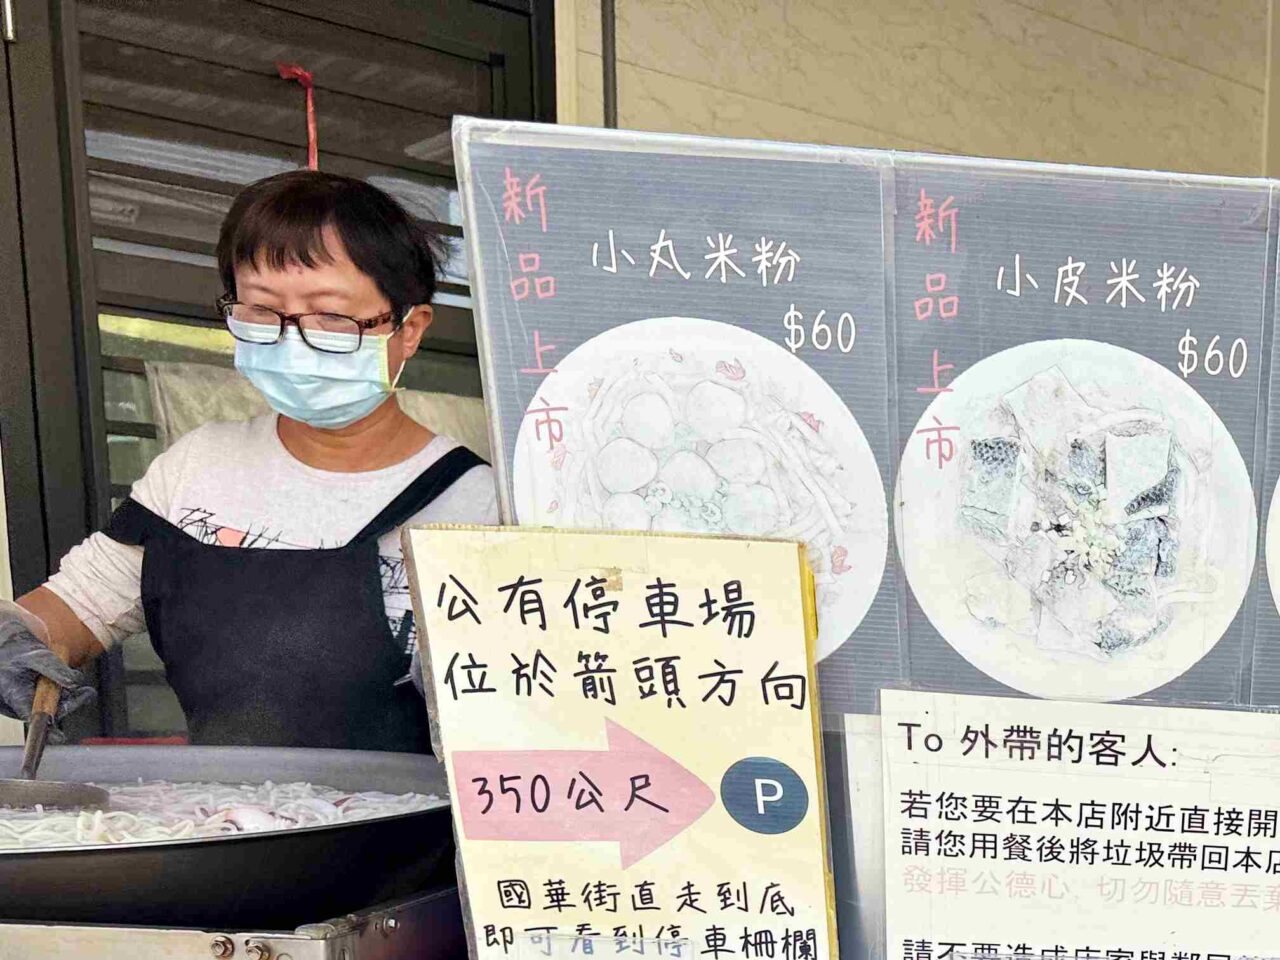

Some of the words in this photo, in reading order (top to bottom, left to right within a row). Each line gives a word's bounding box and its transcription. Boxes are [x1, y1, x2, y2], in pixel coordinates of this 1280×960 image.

[591, 228, 801, 287] 小丸米粉
[995, 255, 1200, 308] 小皮米粉
[502, 167, 569, 450] 新品上市
[782, 303, 856, 354] $60
[913, 189, 961, 469] 新品上市
[1176, 329, 1248, 379] $60
[437, 574, 756, 638] 公有停車場
[444, 649, 806, 710] 位於箭頭方向
[897, 721, 943, 754] To
[471, 770, 670, 814] 350公尺
[753, 778, 784, 815] P
[497, 878, 795, 917] 國華街直走到底
[483, 923, 818, 960] 即可看到停車柵欄
